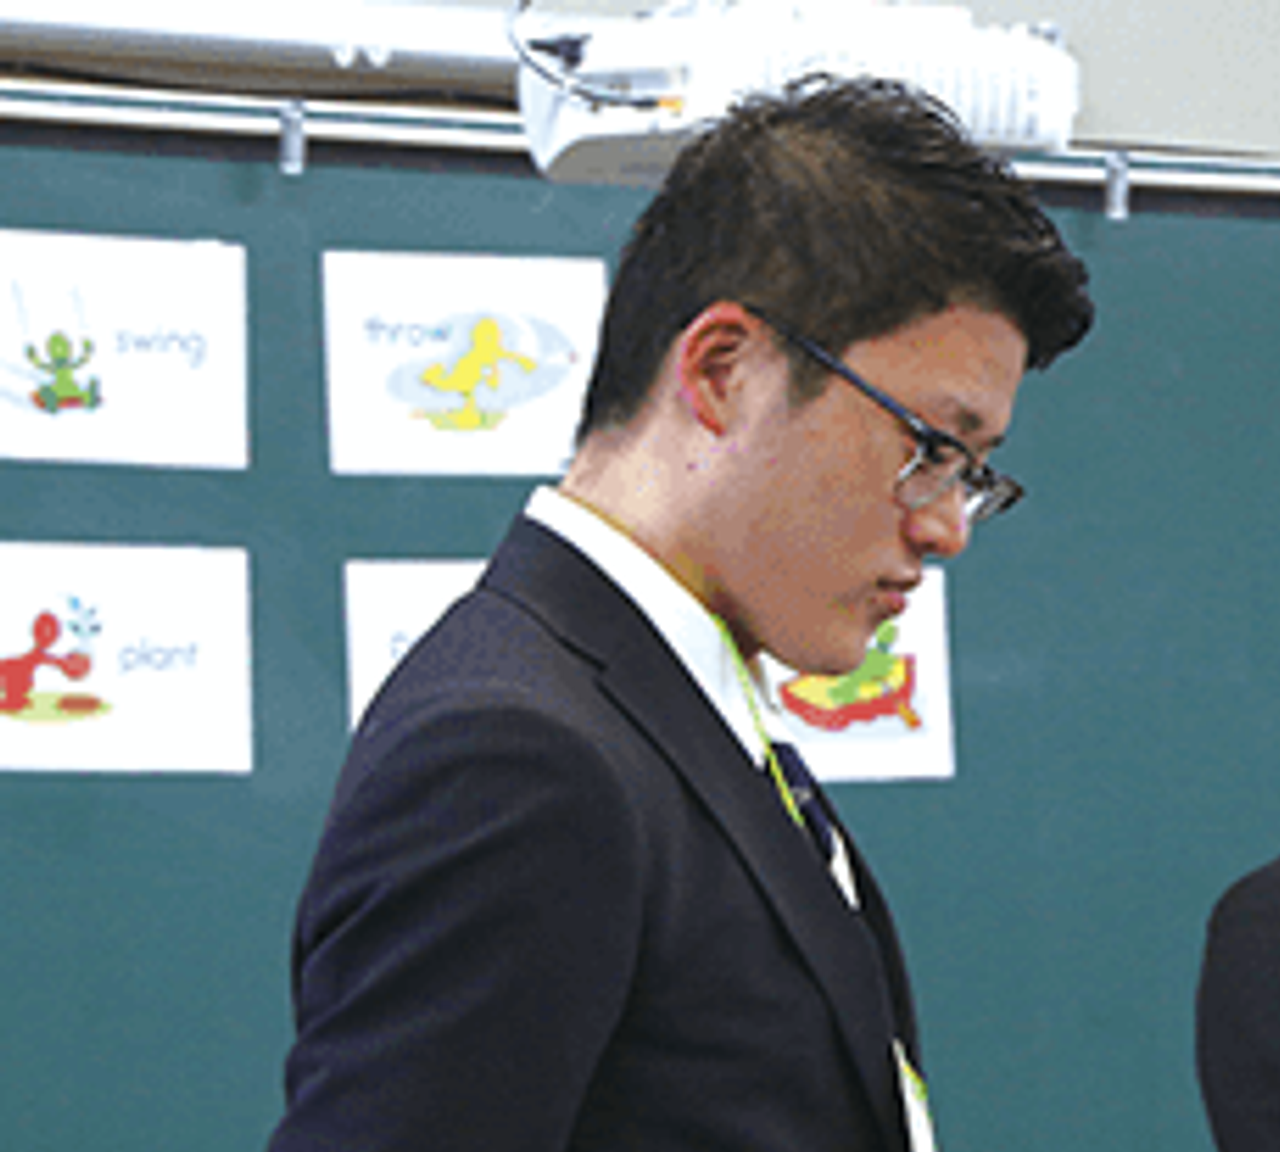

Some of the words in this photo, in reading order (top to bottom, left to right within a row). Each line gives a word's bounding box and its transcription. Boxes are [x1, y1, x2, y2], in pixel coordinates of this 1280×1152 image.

[115, 326, 206, 368] swing
[363, 314, 453, 346] throw
[119, 638, 197, 673] plant
